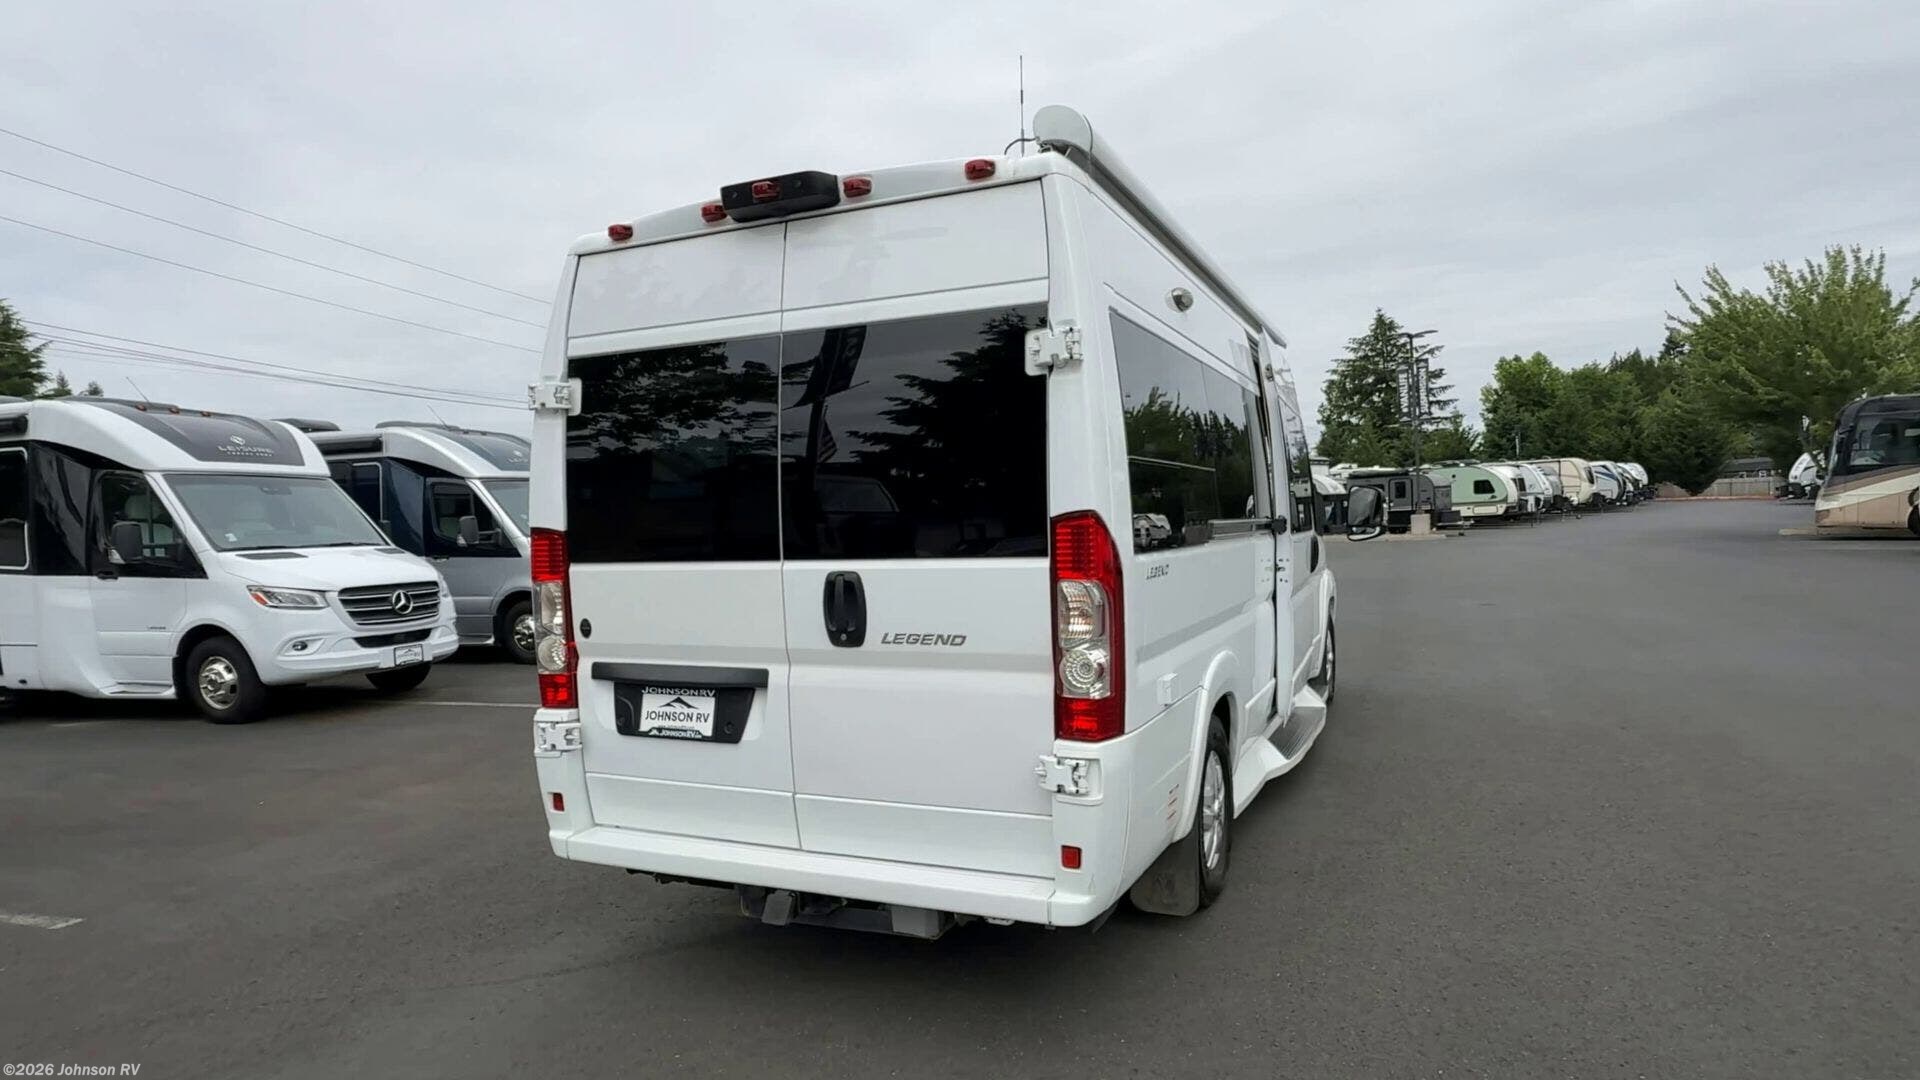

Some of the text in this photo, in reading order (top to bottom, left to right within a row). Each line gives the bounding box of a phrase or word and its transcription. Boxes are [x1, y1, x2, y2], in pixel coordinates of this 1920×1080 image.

[218, 445, 274, 454] LEISURE
[881, 632, 967, 646] LEGEND
[645, 710, 710, 723] JOHNSON RV
